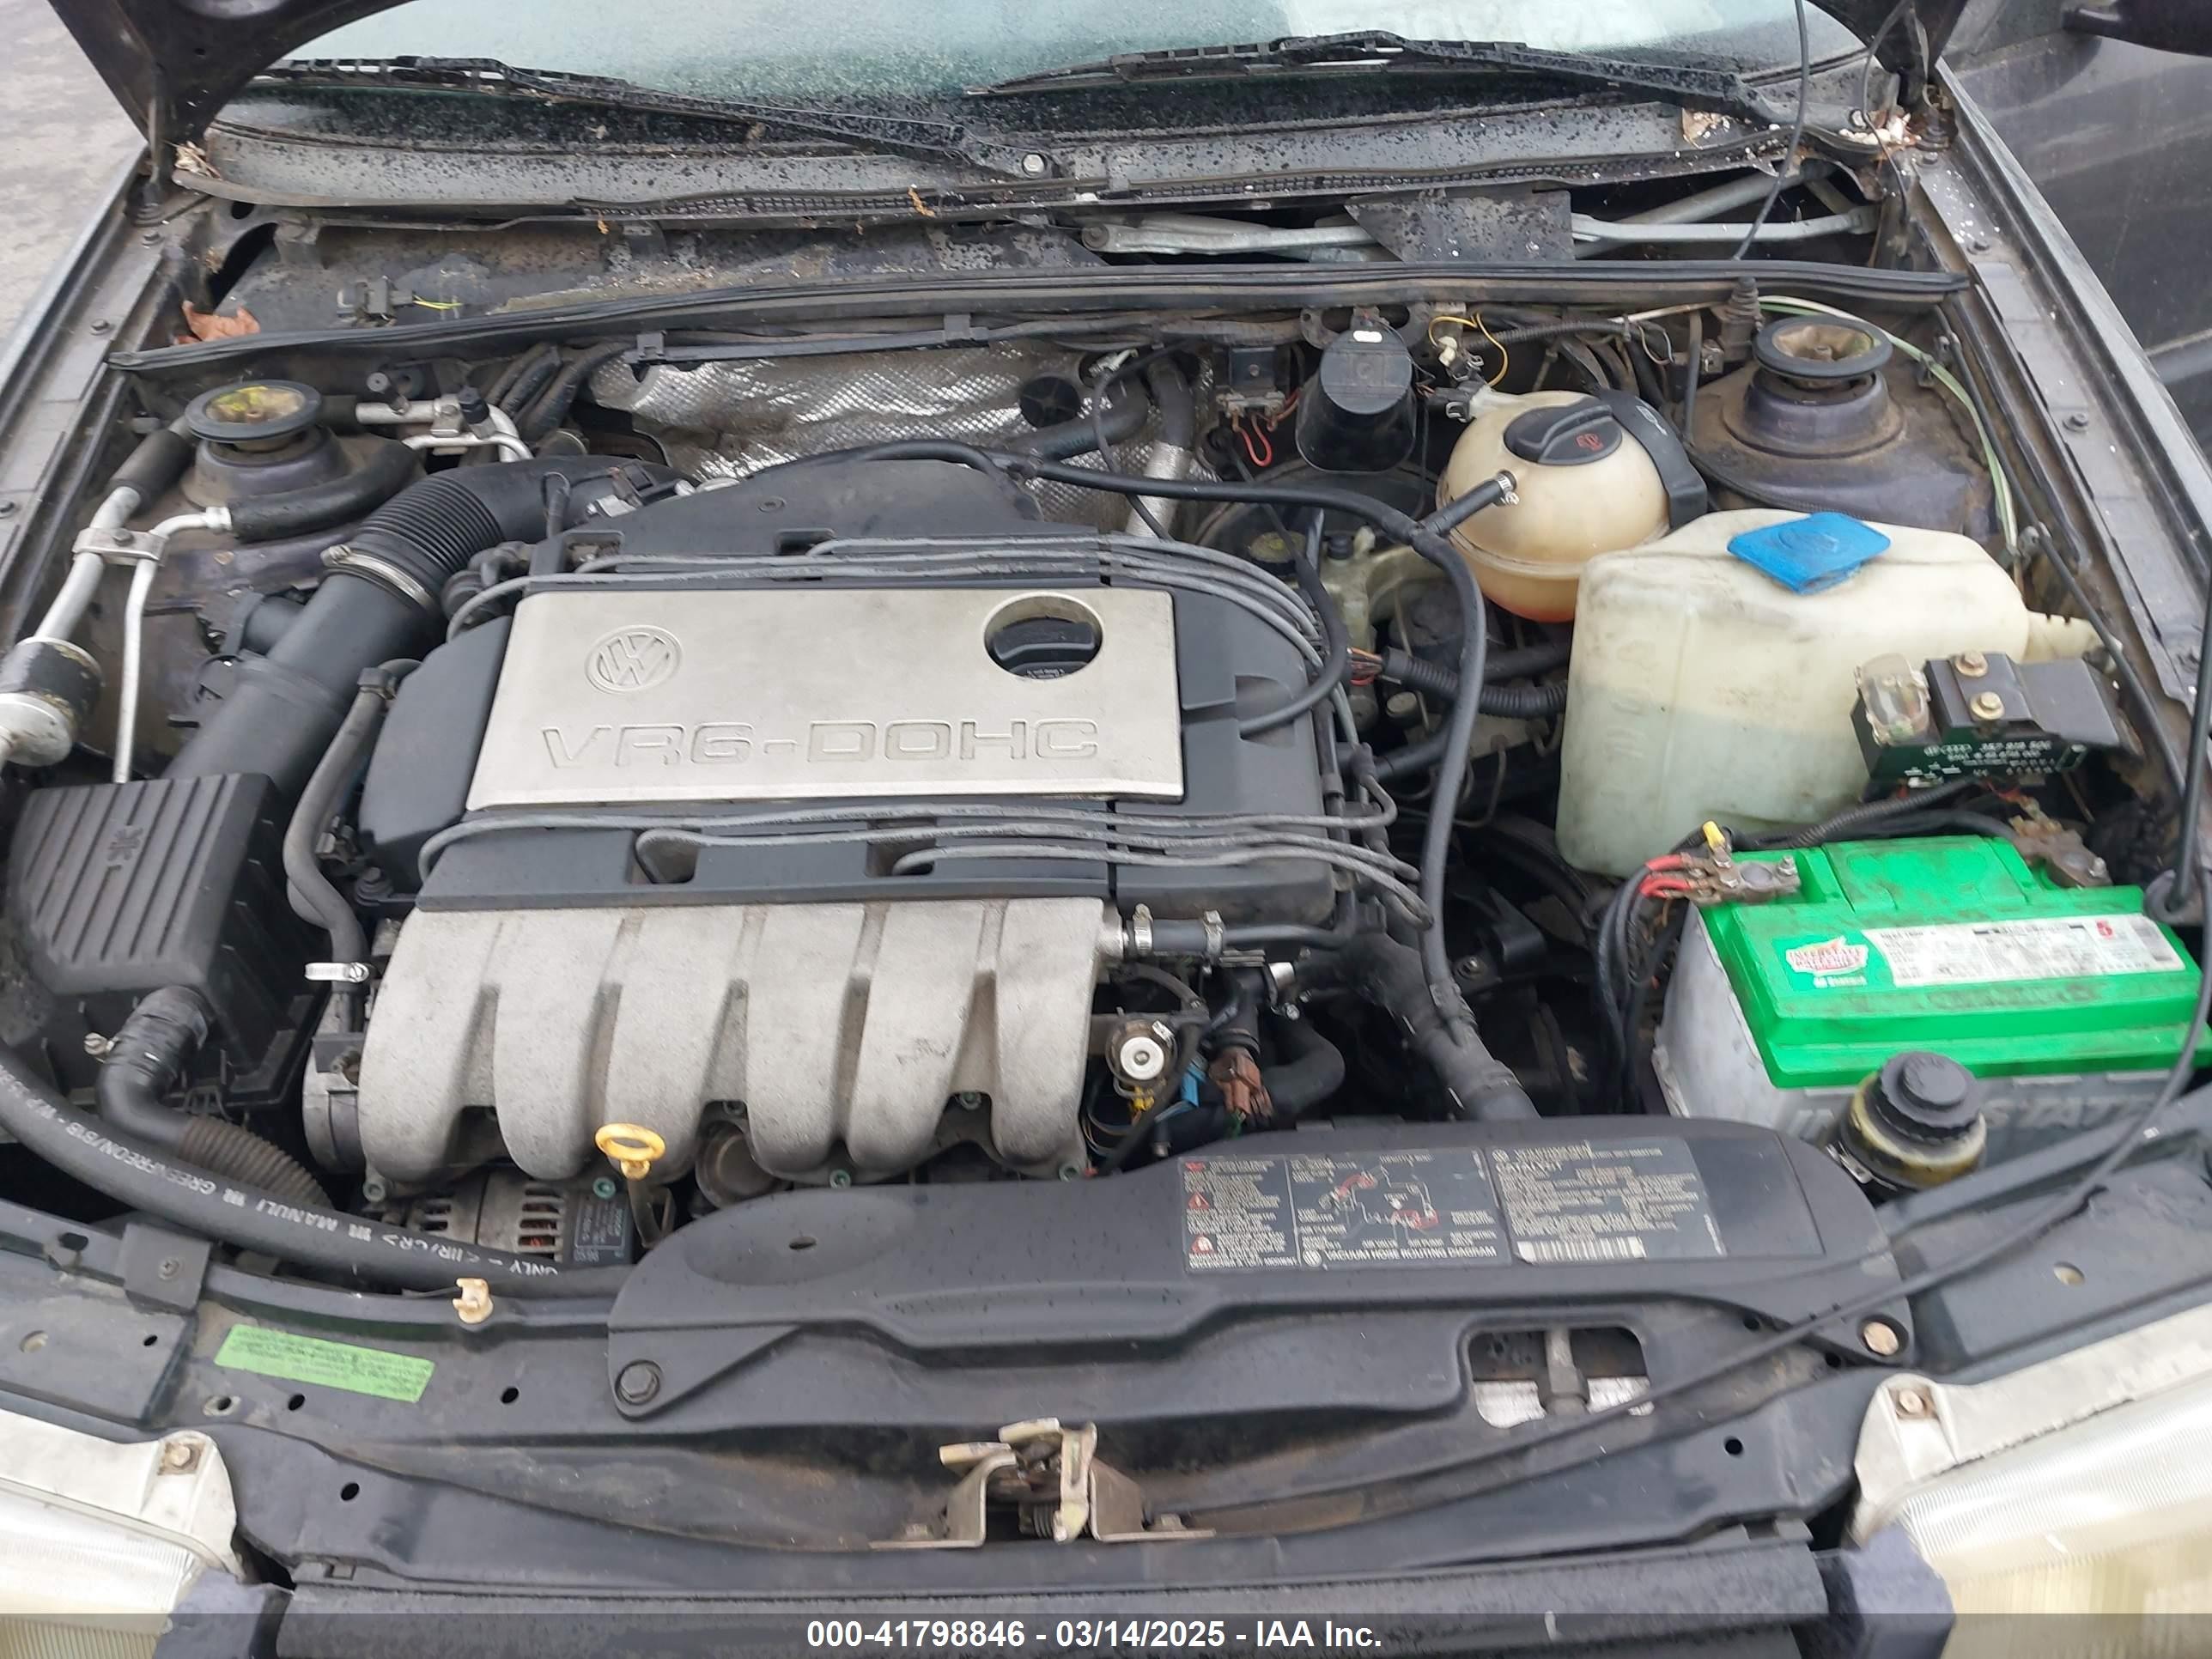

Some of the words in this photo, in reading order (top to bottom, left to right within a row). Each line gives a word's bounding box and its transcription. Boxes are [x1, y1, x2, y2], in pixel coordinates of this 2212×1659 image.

[540, 718, 1099, 769] VR6-DOHC
[256, 1198, 338, 1232] MANULI
[1325, 1249, 1370, 1261] VACUUM
[1447, 1245, 1498, 1259] DIAGRAM
